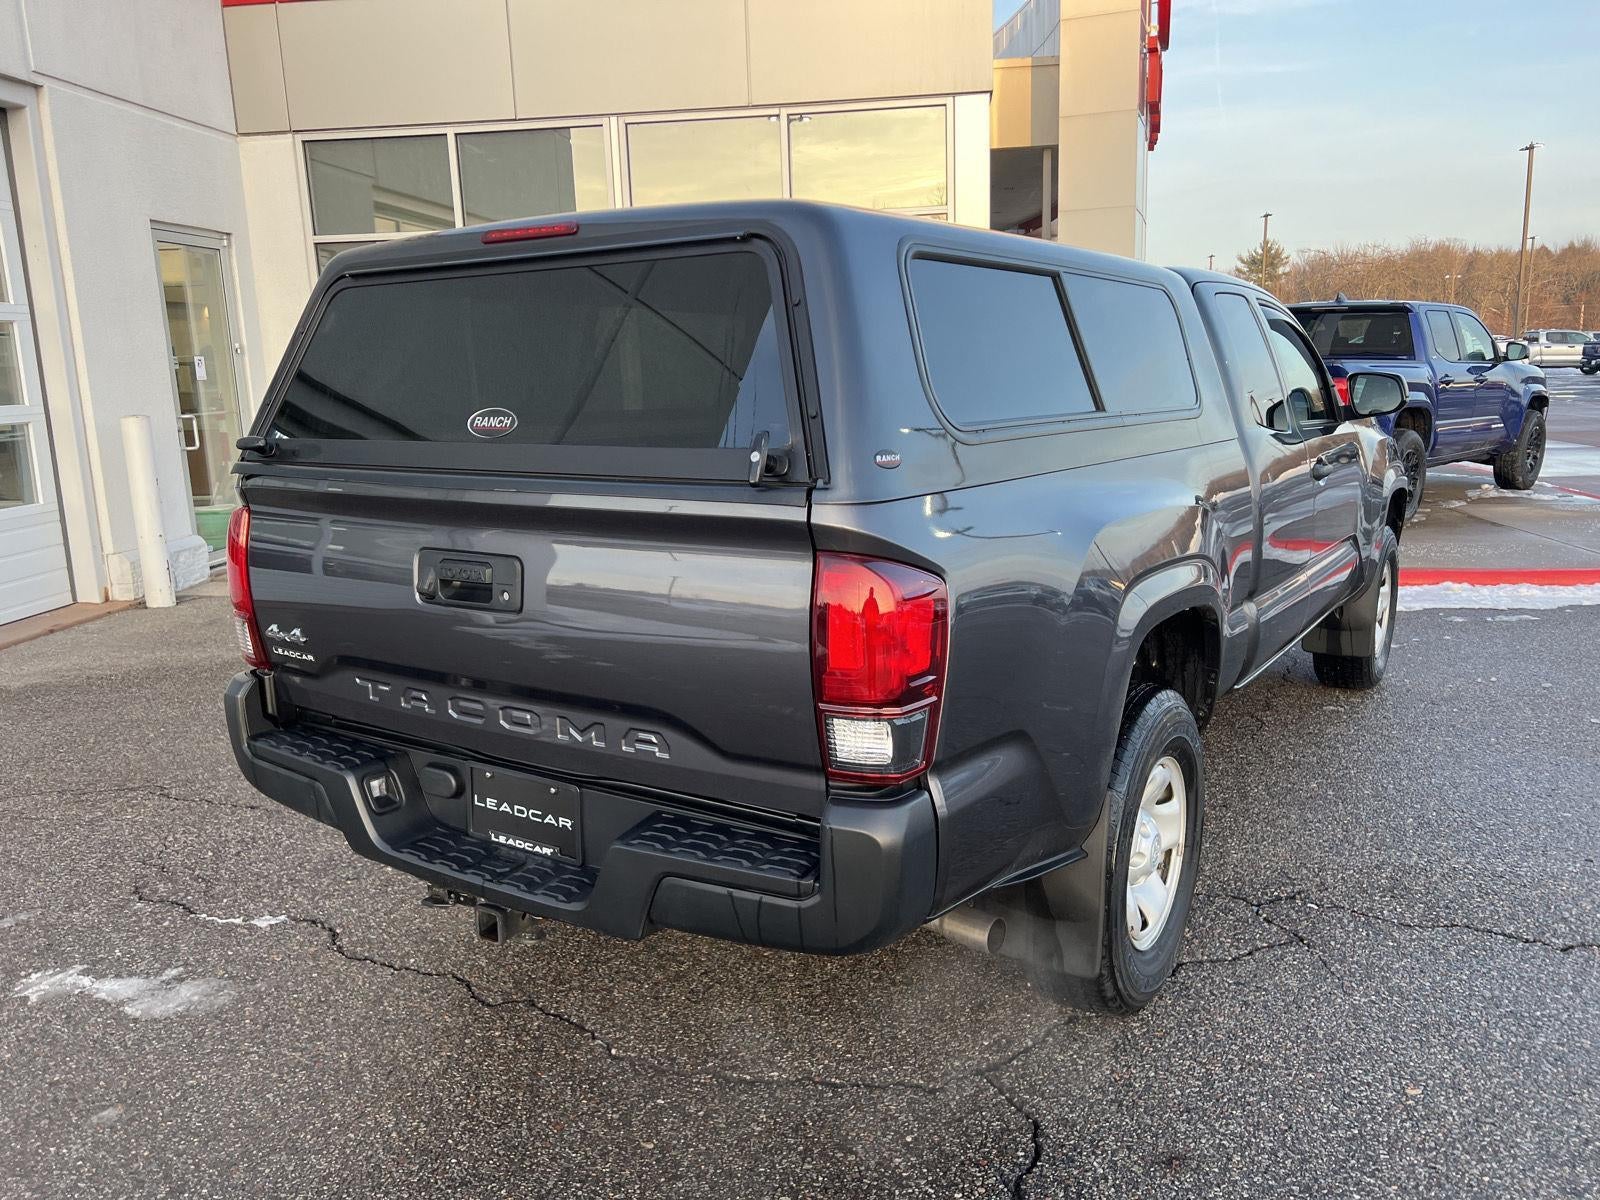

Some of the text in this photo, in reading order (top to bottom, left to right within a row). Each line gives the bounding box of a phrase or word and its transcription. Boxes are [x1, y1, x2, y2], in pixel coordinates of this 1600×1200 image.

[473, 416, 512, 428] RANCH
[876, 454, 900, 463] RANCH
[441, 566, 486, 582] TOYOTA
[272, 646, 315, 662] LEADCAR
[354, 676, 670, 759] TACOMA
[474, 794, 573, 831] LEADCAR
[491, 833, 554, 856] LEADCAR
